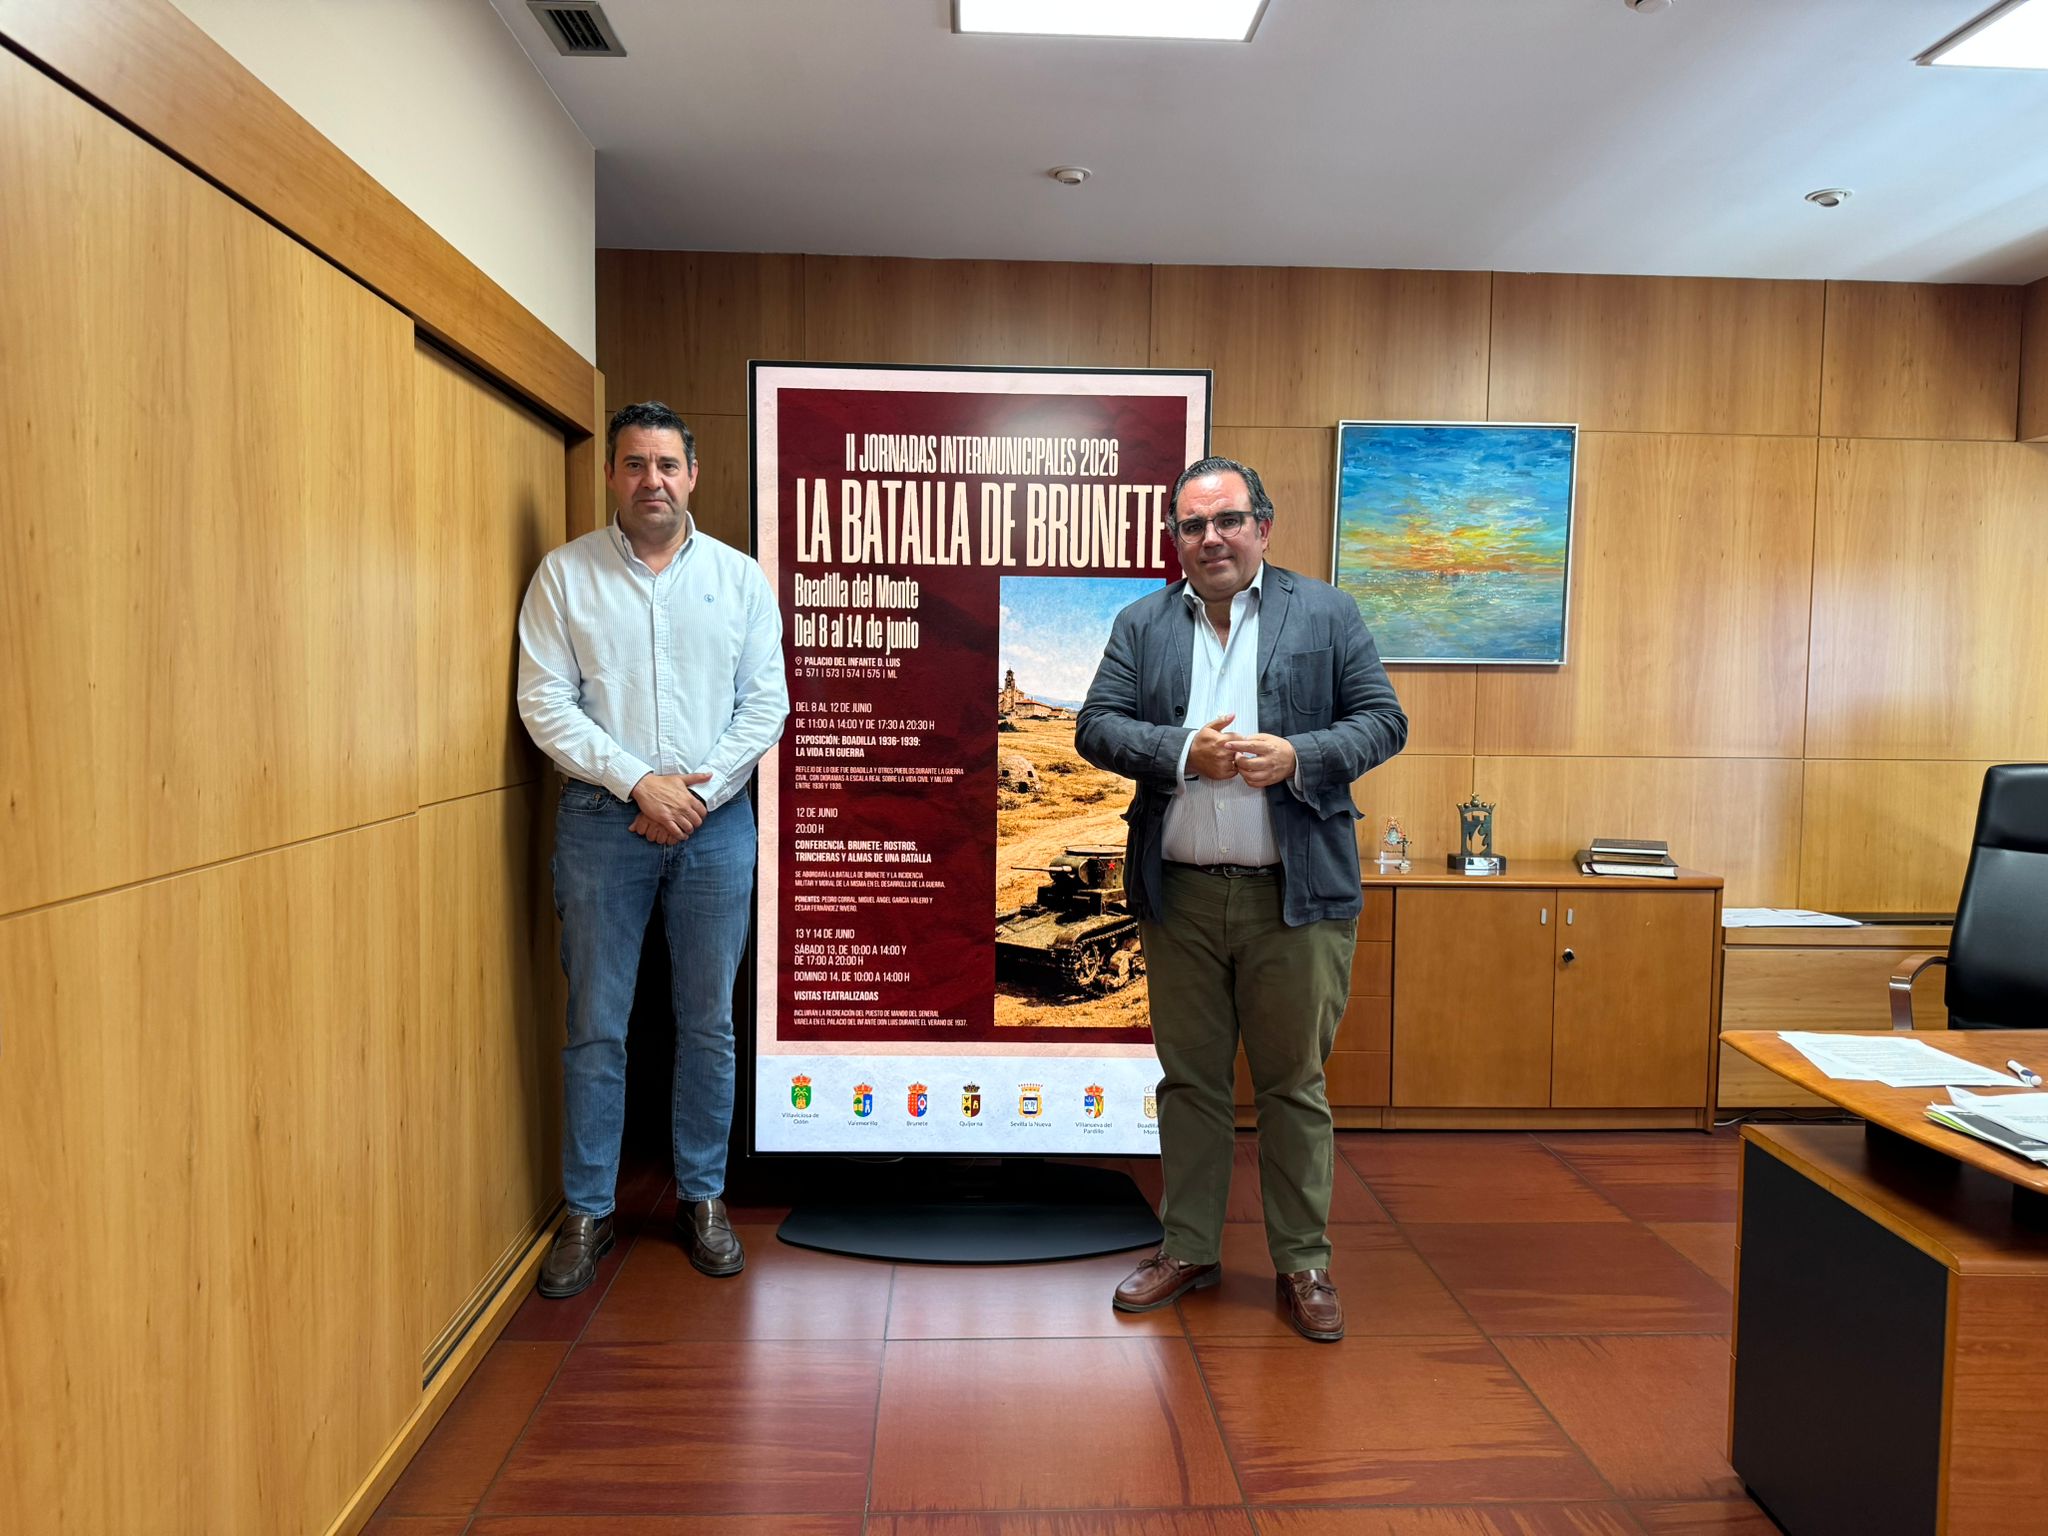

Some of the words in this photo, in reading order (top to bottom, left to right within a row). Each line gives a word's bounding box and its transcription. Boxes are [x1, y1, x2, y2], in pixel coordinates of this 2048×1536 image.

[846, 433, 855, 471] II
[859, 433, 937, 473] JORNADAS
[941, 435, 1077, 476] INTERMUNICIPALES
[1080, 438, 1119, 477] 2026
[797, 478, 832, 564] LA
[842, 478, 971, 566] BATALLA
[981, 481, 1016, 567] DE
[1026, 482, 1166, 569] BRUNETE
[795, 572, 848, 608] Boadilla
[852, 573, 871, 609] del
[876, 574, 919, 610] Monte
[795, 613, 816, 648] Del
[818, 614, 827, 648] 8
[831, 614, 843, 648] al
[846, 614, 862, 648] 14
[865, 615, 883, 649] de
[886, 615, 919, 655] junio
[805, 656, 832, 666] PALACIO
[834, 657, 847, 667] DEL
[848, 657, 876, 667] INFANTE
[878, 657, 884, 667] D.
[886, 658, 900, 667] LUIS
[806, 669, 818, 678] 571
[826, 669, 840, 678] 573
[846, 669, 860, 678] 574
[867, 669, 880, 679] 575
[888, 669, 897, 679] ML
[796, 702, 809, 712] DEL
[818, 702, 828, 712] AL
[830, 702, 839, 713] 12
[840, 702, 850, 713] DE
[852, 702, 872, 713] JUNIO
[796, 719, 805, 729] DE
[808, 719, 827, 729] 11:00
[837, 719, 857, 730] 14:00
[858, 719, 864, 730] Y
[866, 719, 875, 730] DE
[878, 720, 898, 730] 17:30
[906, 720, 928, 730] 20:30
[796, 734, 840, 745] EXPOSICIÓN:
[842, 736, 876, 746] BOADILLA
[879, 736, 920, 746] 1936-1939:
[796, 747, 805, 757] LA
[807, 747, 824, 757] VIDA
[825, 748, 834, 758] EN
[836, 748, 864, 758] GUERRA
[796, 807, 805, 818] 12
[806, 807, 816, 818] DE
[818, 808, 838, 818] JUNIO
[796, 823, 817, 834] 20:00
[796, 840, 846, 850] CONFERENCIA.
[848, 840, 882, 851] BRUNETE:
[884, 841, 918, 851] ROSTROS,
[796, 852, 840, 863] TRINCHERAS
[848, 853, 872, 863] ALMAS
[874, 853, 884, 863] DE
[885, 853, 900, 863] UNA
[901, 853, 931, 864] BATALLA
[796, 929, 804, 939] 13
[814, 929, 822, 939] 14
[824, 929, 833, 939] DE
[835, 929, 855, 939] JUNIO
[794, 943, 824, 955] SÁBADO
[839, 945, 848, 955] DE
[851, 945, 871, 955] 10:00
[872, 945, 878, 955] A
[880, 945, 900, 956] 14:00
[901, 945, 907, 956] Y
[794, 955, 804, 965] DE
[806, 956, 826, 966] 17:00
[828, 956, 834, 966] A
[835, 956, 856, 966] 20:00
[794, 971, 827, 982] DOMINGO
[842, 972, 851, 982] DE
[854, 972, 874, 982] 10:00
[883, 972, 903, 982] 14:00
[794, 991, 821, 1001] VISITAS
[822, 991, 878, 1001] TEATRALIZADAS
